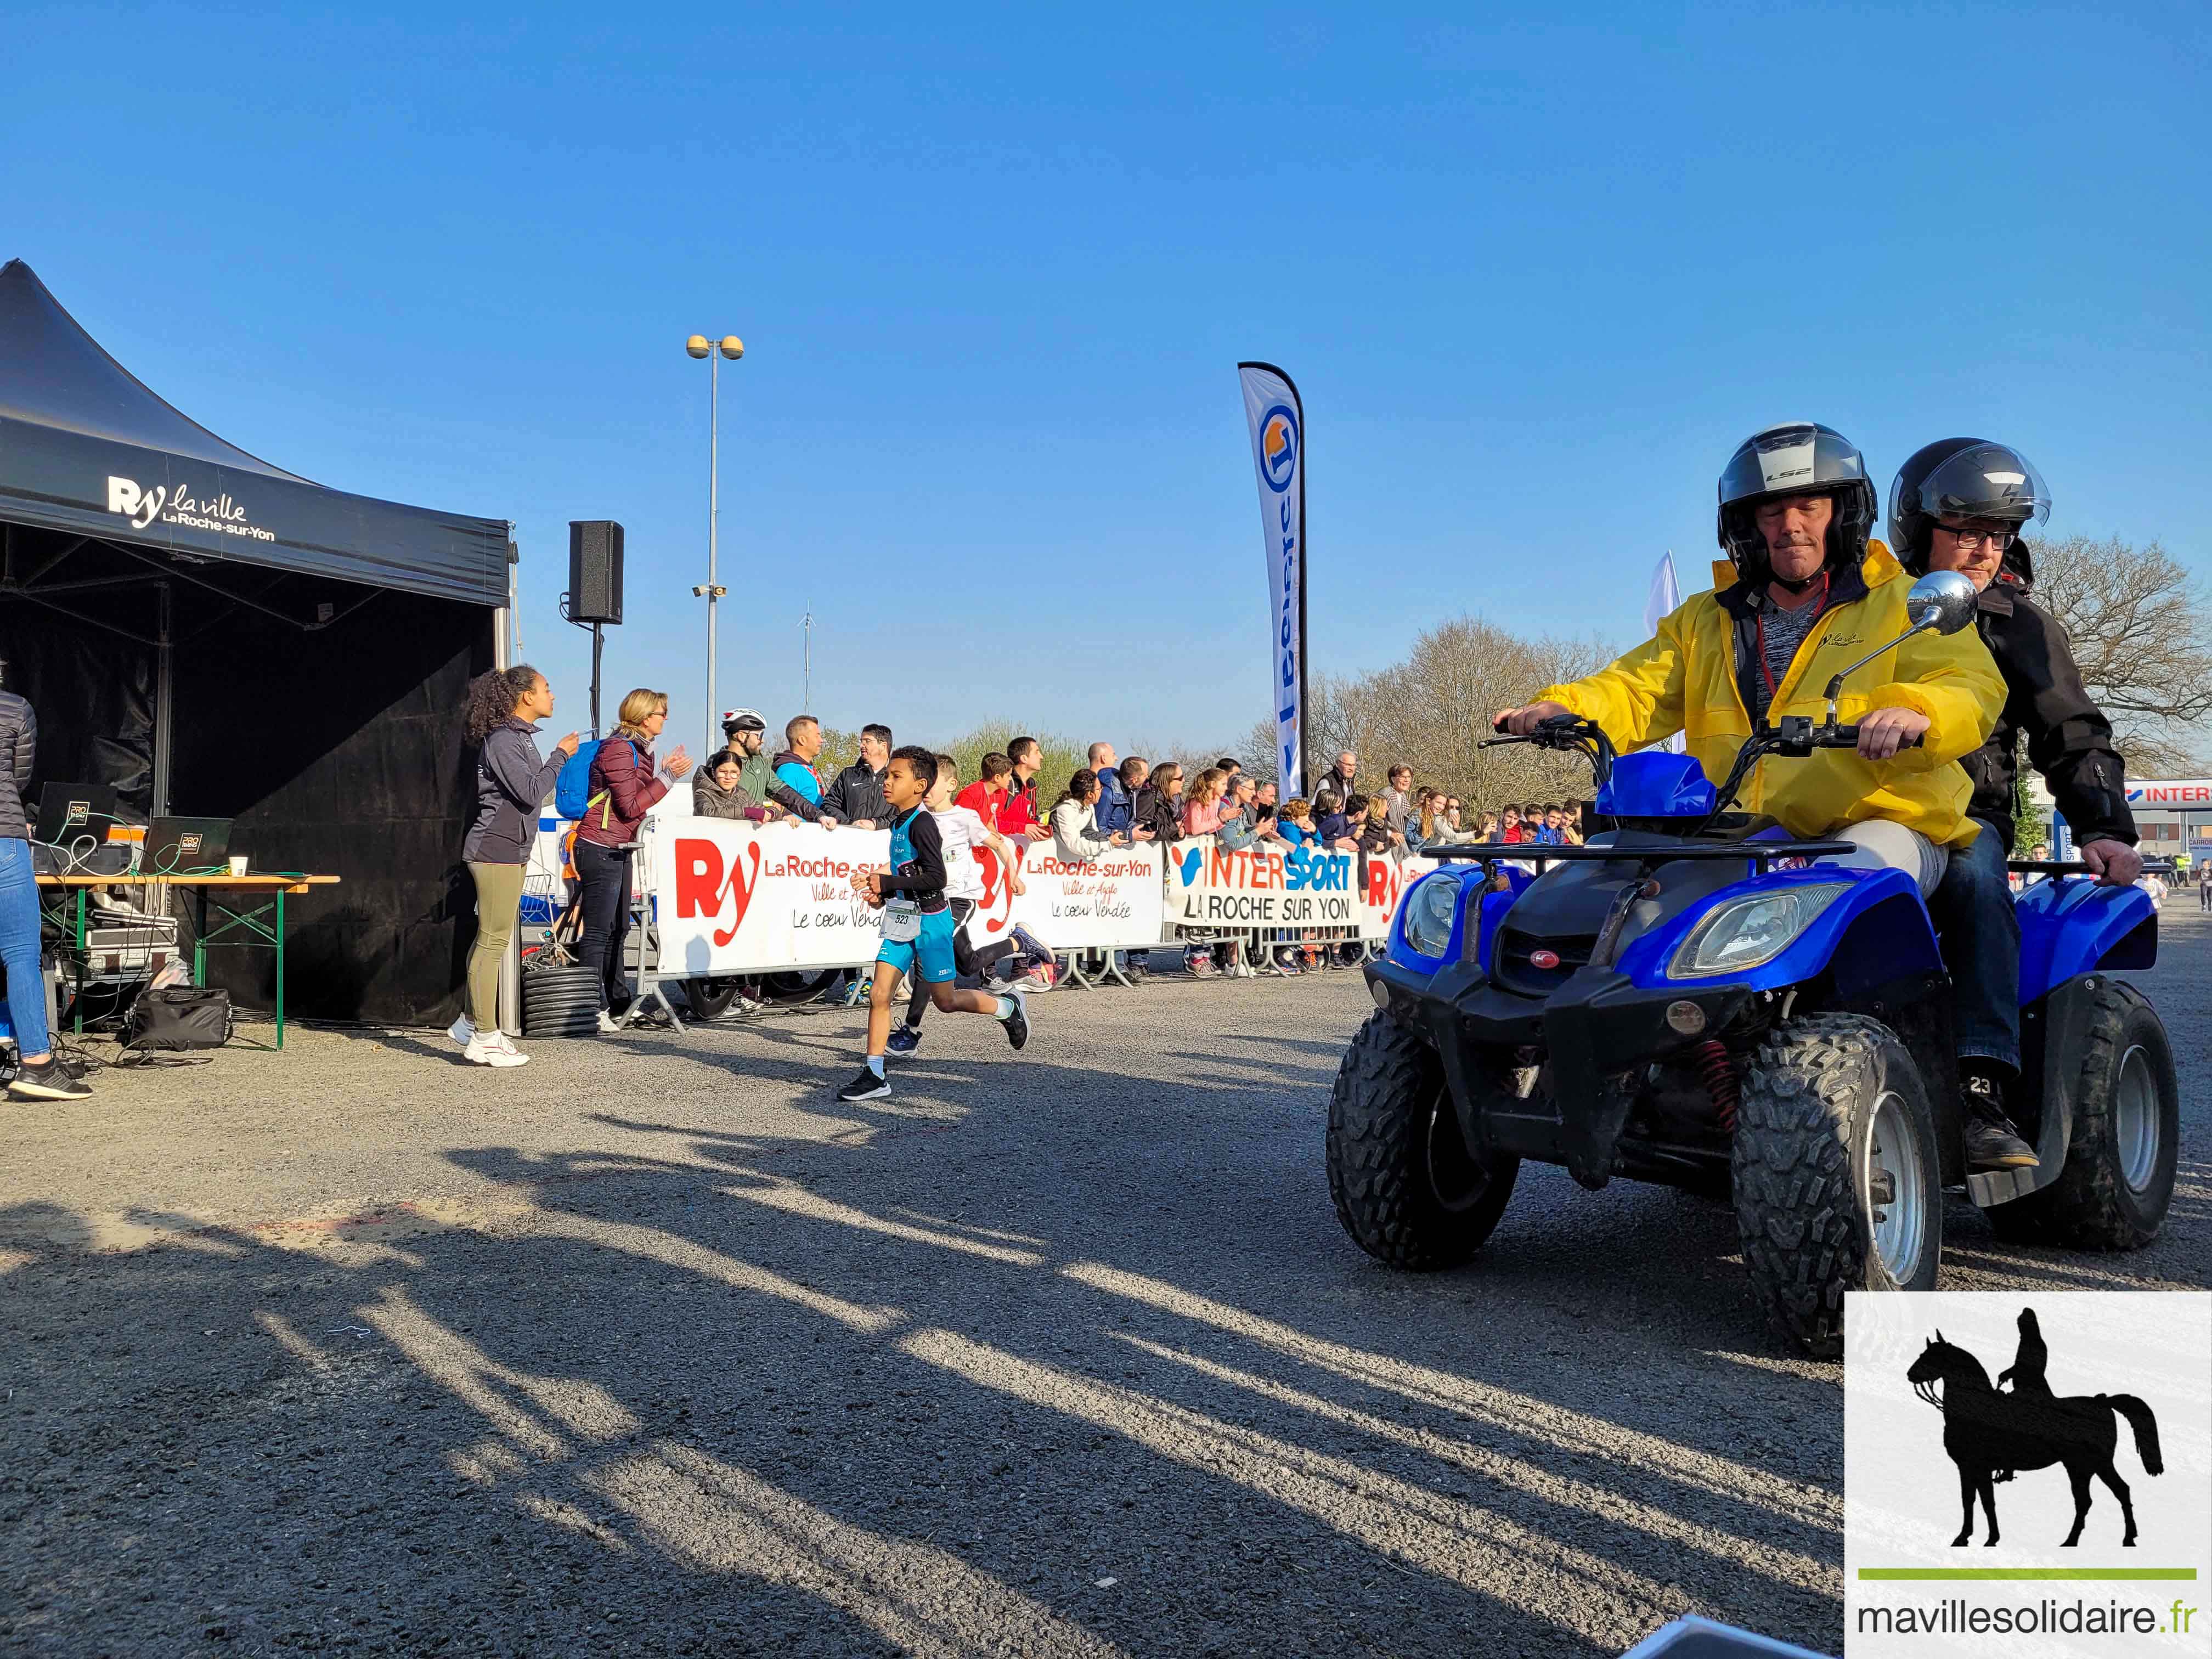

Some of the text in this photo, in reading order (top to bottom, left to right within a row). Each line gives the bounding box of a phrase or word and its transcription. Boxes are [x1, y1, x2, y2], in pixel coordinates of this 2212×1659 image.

[1766, 467, 1812, 482] LS2
[108, 476, 247, 529] Ry la ville
[2146, 788, 2212, 802] INTER
[1204, 847, 1351, 891] INTERSPORT
[675, 838, 760, 947] Ry
[811, 882, 836, 902] Ville
[839, 887, 849, 900] et
[1062, 879, 1118, 905] Ville et Agglo
[1369, 860, 1403, 923] Ry
[793, 909, 809, 928] Le
[851, 906, 884, 928] Vend
[1052, 900, 1061, 917] Le
[1095, 899, 1131, 918] Vendée
[1184, 894, 1350, 921] LA ROCHE SUR YON
[895, 915, 909, 925] 523
[1970, 1076, 1990, 1093] 23
